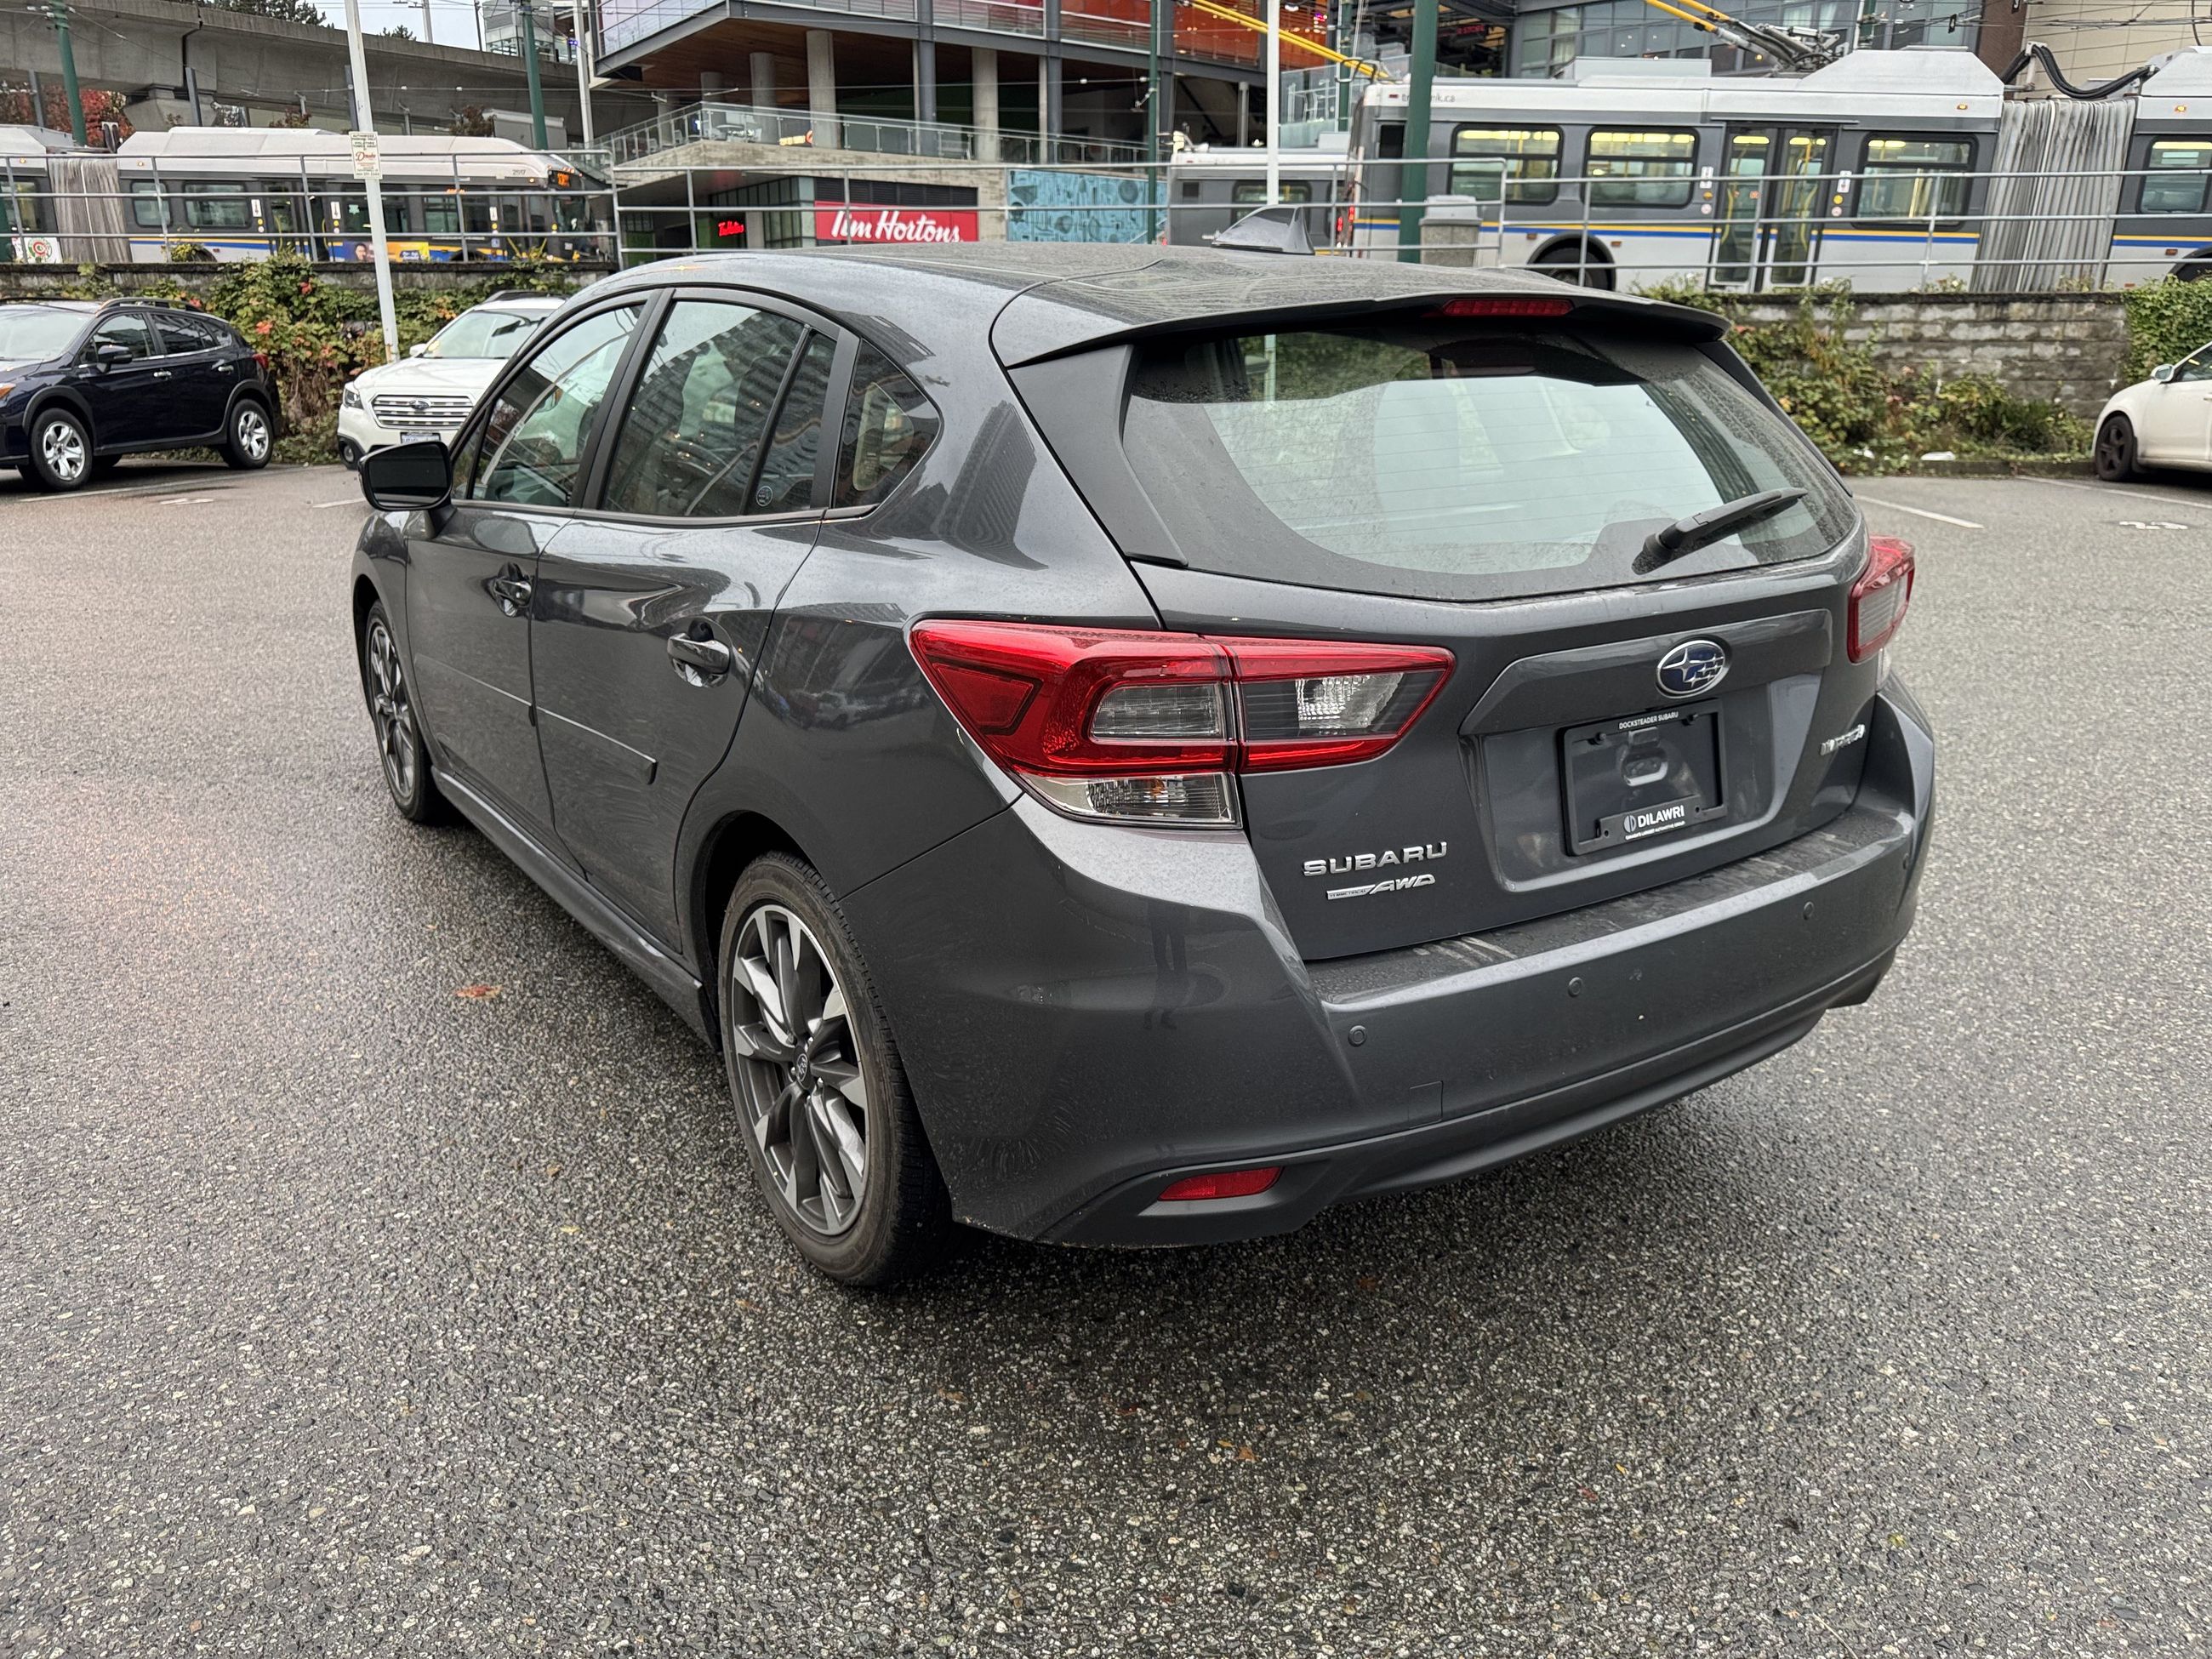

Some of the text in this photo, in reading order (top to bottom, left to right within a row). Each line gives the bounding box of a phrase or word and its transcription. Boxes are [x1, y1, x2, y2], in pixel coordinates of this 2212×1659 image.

[830, 210, 961, 242] Tim Hortons
[1618, 711, 1679, 730] DOCKSTEADER SUBARU
[1637, 805, 1685, 828] DILAWRI
[1303, 841, 1447, 877] SUBARU
[1370, 874, 1436, 895] AWD
